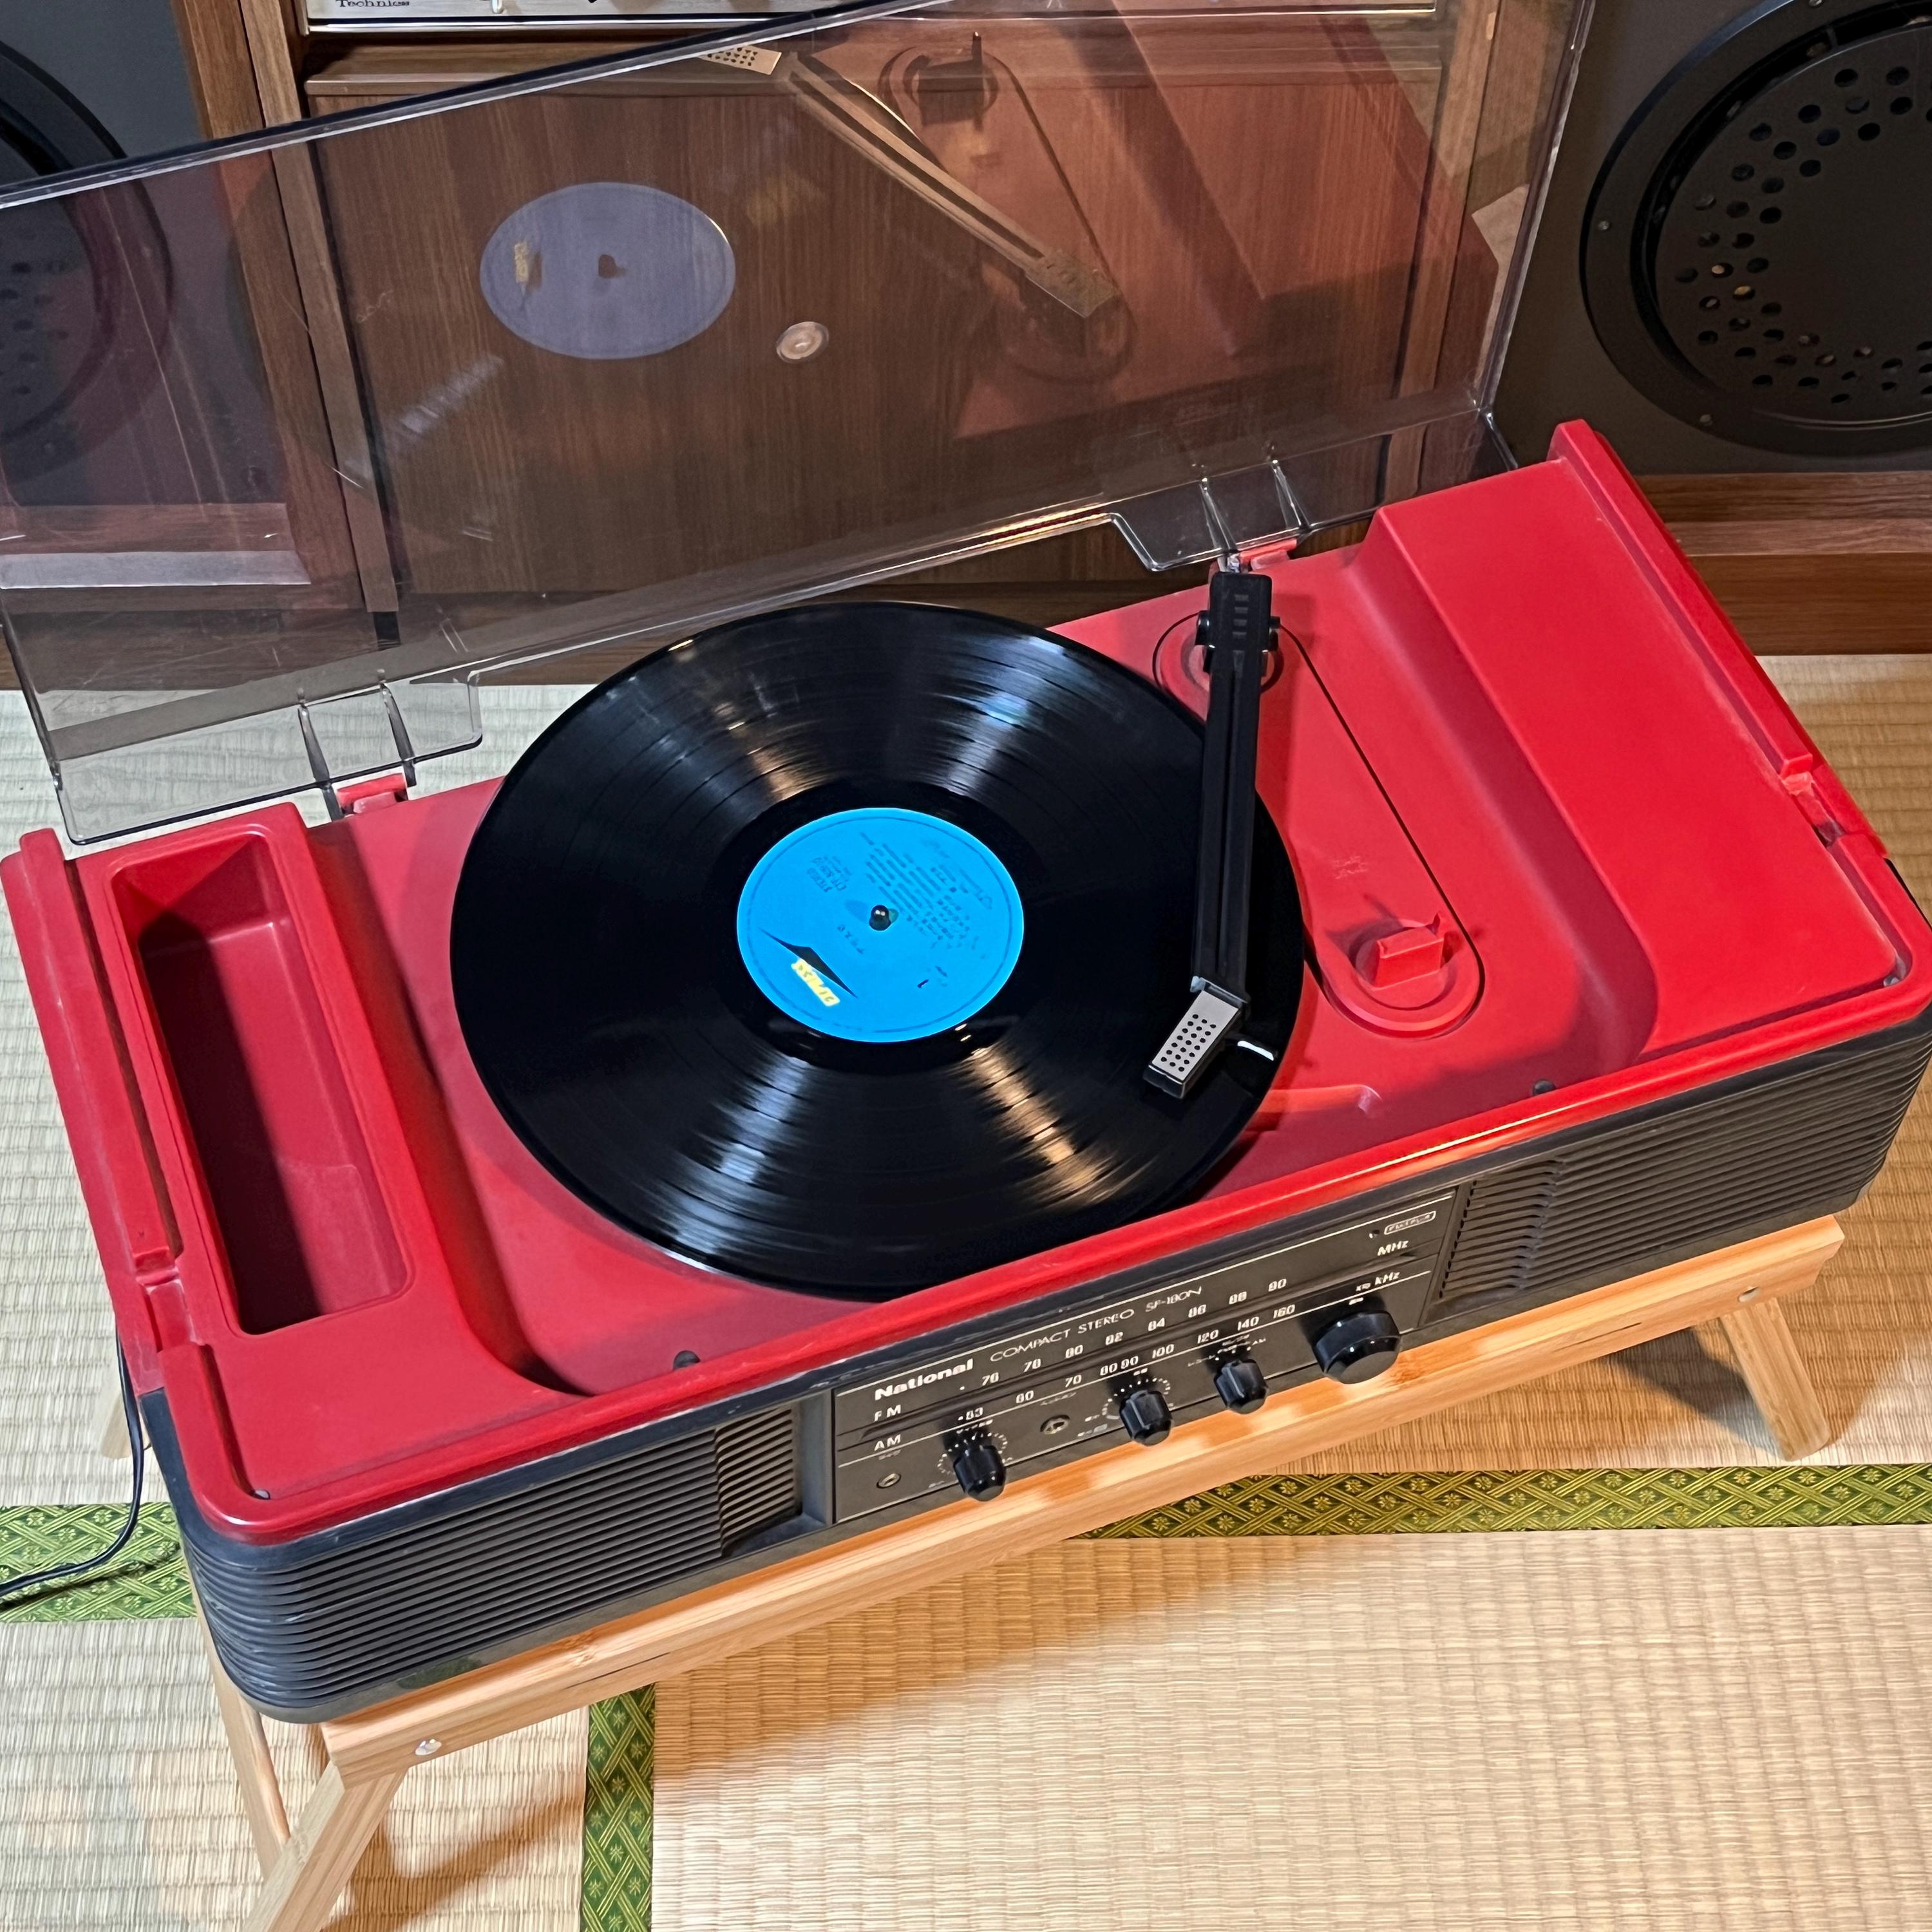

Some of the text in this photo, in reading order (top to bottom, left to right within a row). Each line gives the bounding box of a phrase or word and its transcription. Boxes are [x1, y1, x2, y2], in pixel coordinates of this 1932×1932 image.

[875, 1405, 901, 1421] FM
[1377, 1240, 1409, 1256] MHz
[875, 1358, 973, 1400] National
[990, 1329, 1071, 1361] COMPACT
[1077, 1309, 1135, 1334] STEREO
[875, 1434, 901, 1451] AM
[1152, 1343, 1174, 1359] 100
[1197, 1329, 1219, 1344] 120
[1237, 1316, 1260, 1331] 140
[1273, 1304, 1296, 1319] 160
[1375, 1272, 1400, 1285] kHz
